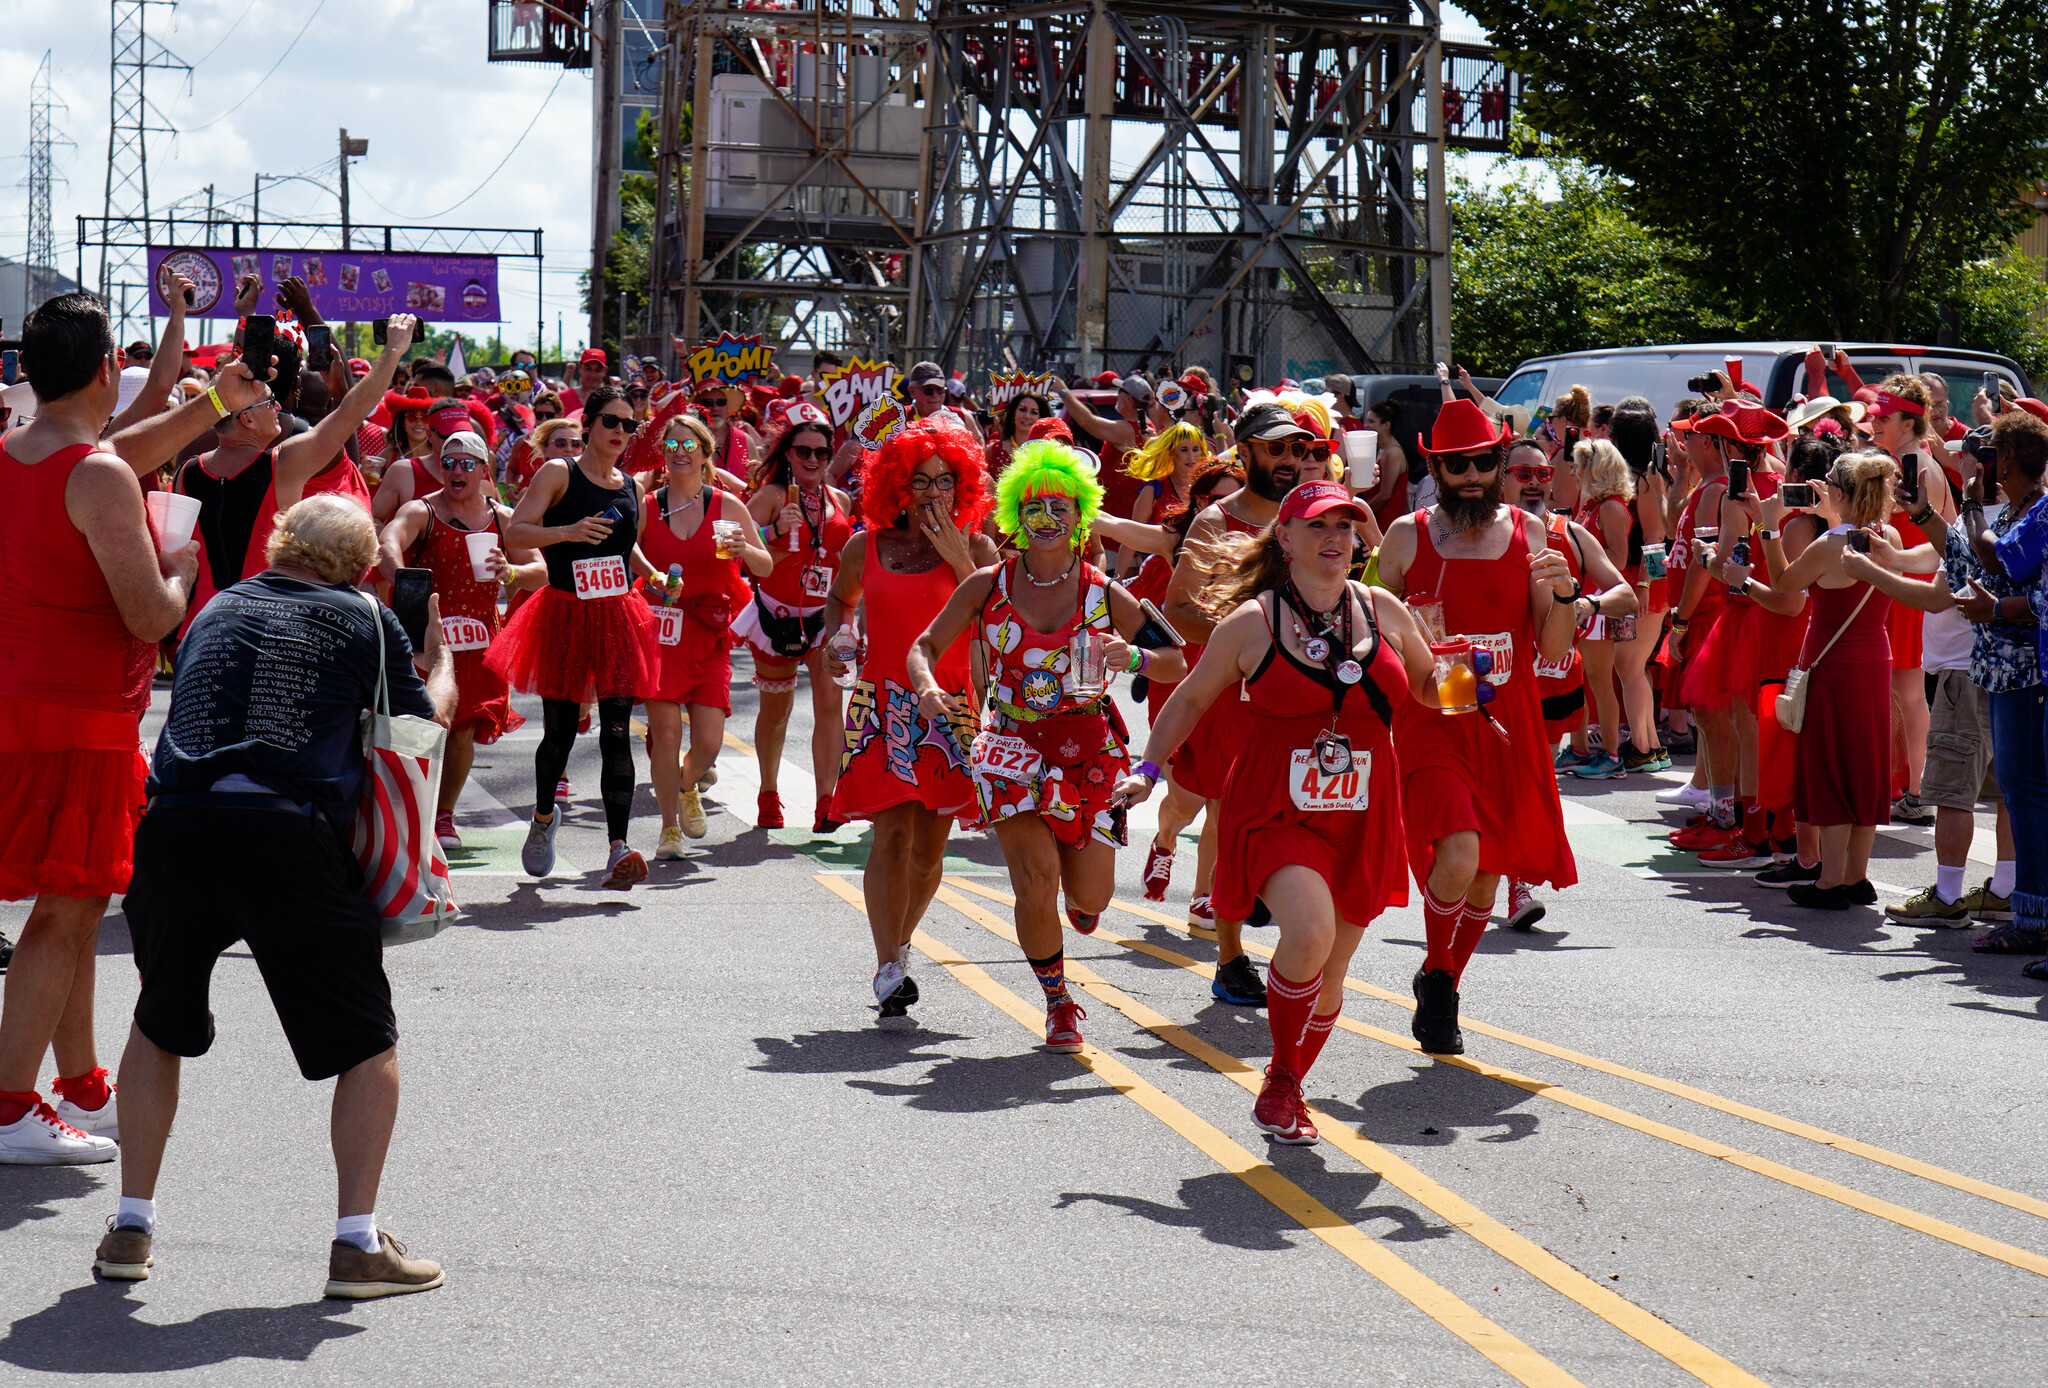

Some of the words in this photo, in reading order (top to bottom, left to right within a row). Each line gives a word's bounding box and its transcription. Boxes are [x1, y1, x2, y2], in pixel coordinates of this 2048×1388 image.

[339, 296, 395, 314] FINISH
[688, 346, 773, 385] BOOM!
[498, 379, 532, 394] BOOM
[824, 366, 895, 428] BAM!
[860, 406, 900, 441] BANG!
[1300, 486, 1314, 496] Red
[576, 562, 588, 570] RED
[589, 560, 608, 568] DRESS
[575, 566, 625, 593] 3466
[234, 599, 312, 614] AMERICAN
[317, 607, 357, 633] TOUR
[267, 618, 334, 642] PHILADELPHIA,
[336, 637, 347, 649] PA
[322, 641, 336, 651] CT
[1494, 637, 1508, 647] RUN
[305, 654, 318, 663] CA
[275, 663, 305, 674] DIEGO,
[307, 669, 320, 678] CA
[303, 685, 318, 693] NV
[304, 677, 316, 686] AZ
[1024, 679, 1059, 699] BOOM!
[280, 697, 294, 705] OK
[291, 692, 305, 700] CO
[995, 738, 1023, 750] DRESS
[971, 741, 1041, 774] 3627
[1352, 756, 1369, 766] RUN
[1301, 767, 1359, 800] 420
